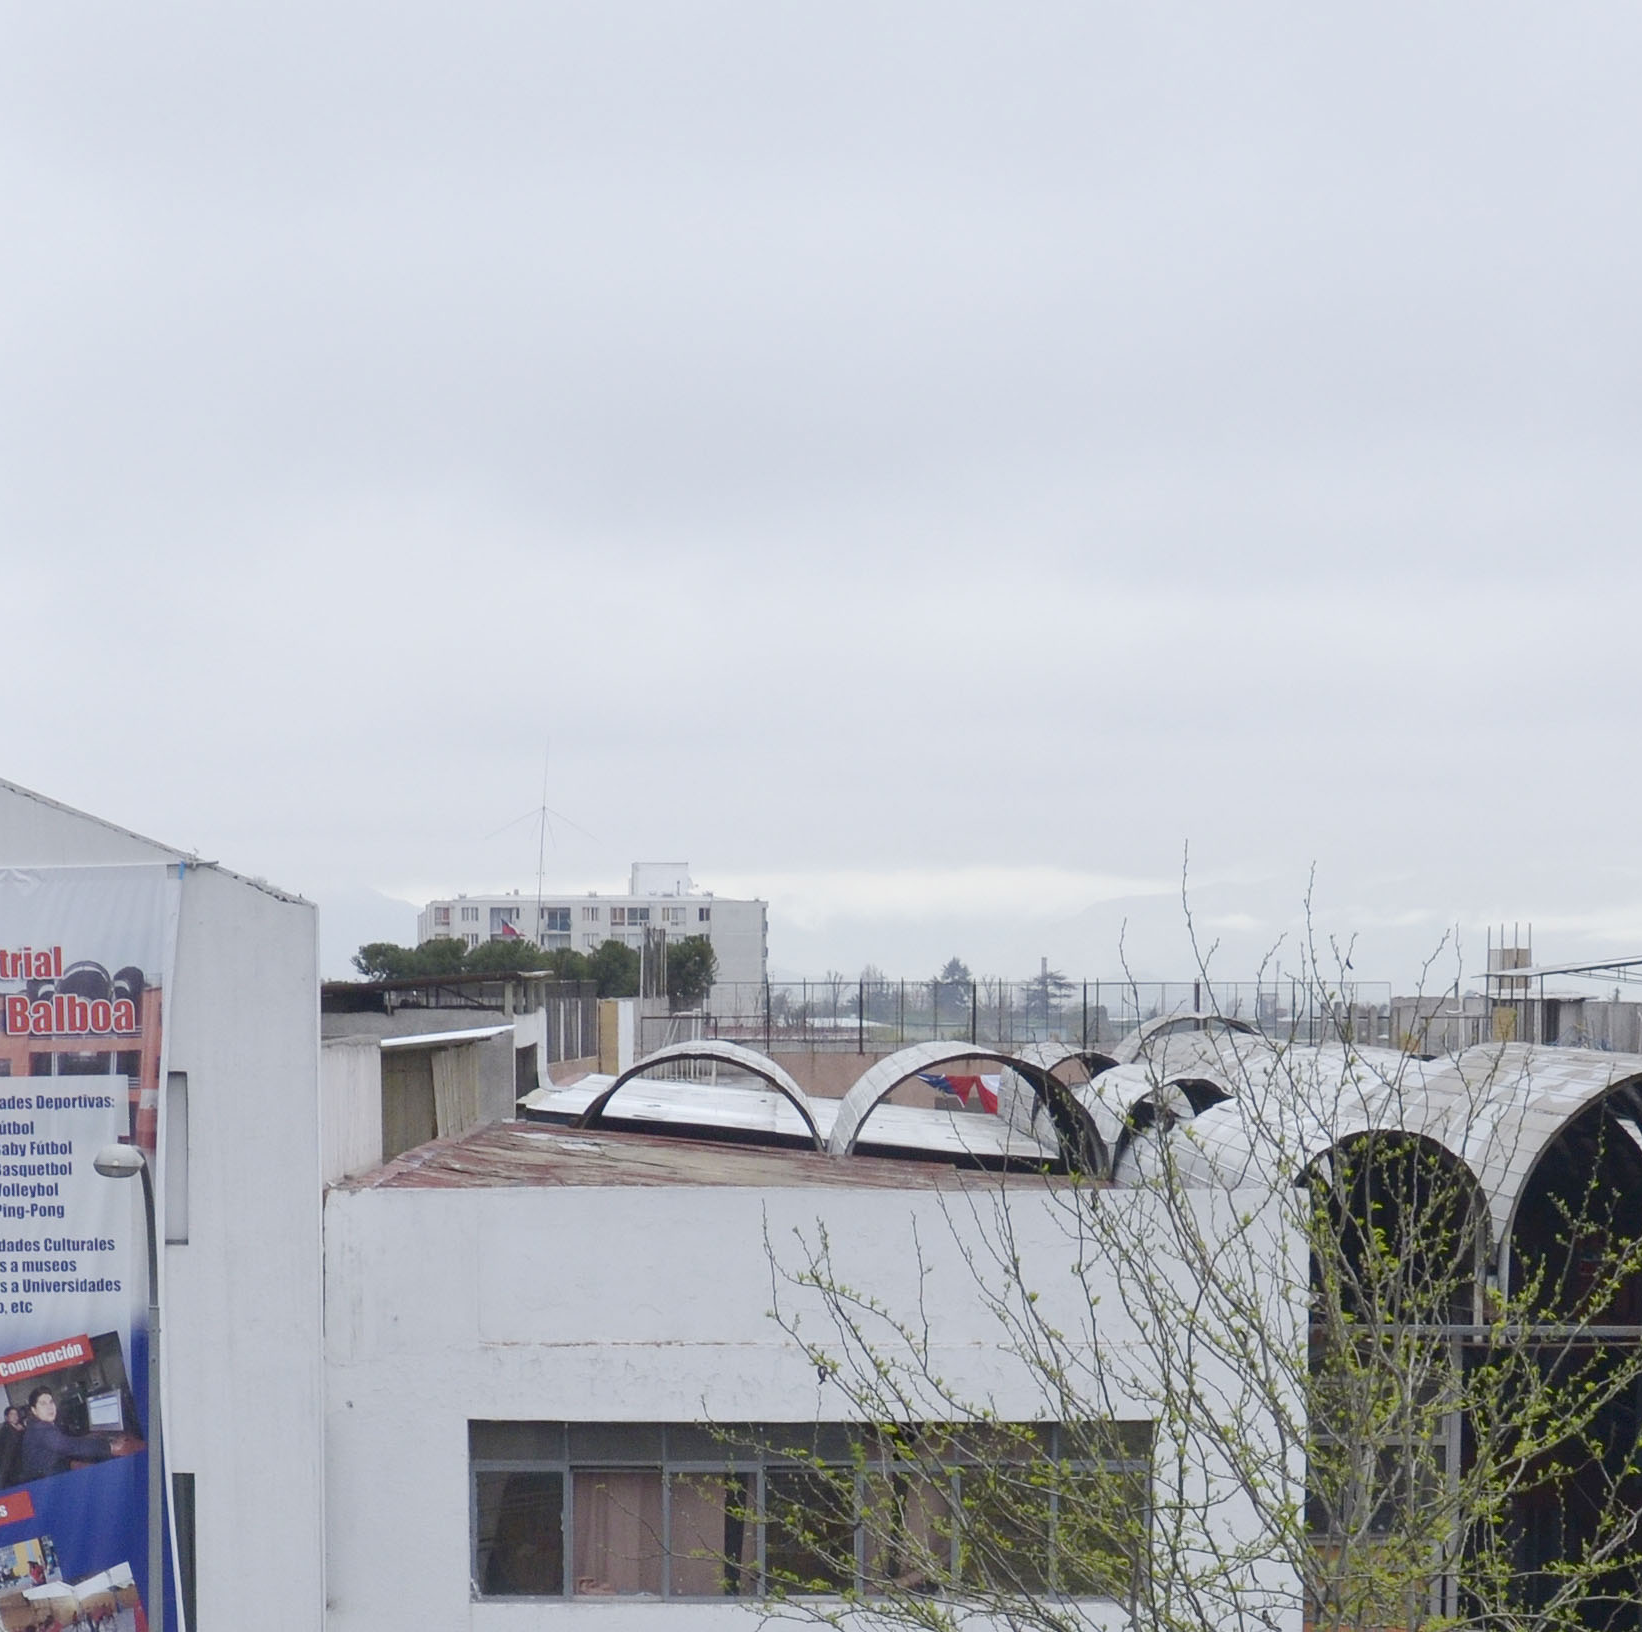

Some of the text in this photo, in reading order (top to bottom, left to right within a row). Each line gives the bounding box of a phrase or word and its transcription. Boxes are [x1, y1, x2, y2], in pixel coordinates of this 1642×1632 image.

[5, 993, 137, 1035] Balboa
[36, 1094, 115, 1110] Deportivas:
[30, 1140, 72, 1155] Fútbol
[44, 1237, 115, 1252] Culturales
[10, 1261, 18, 1272] a
[22, 1260, 77, 1272] museos
[11, 1281, 19, 1293] a
[22, 1278, 121, 1293] Universidades
[10, 1300, 33, 1314] etc
